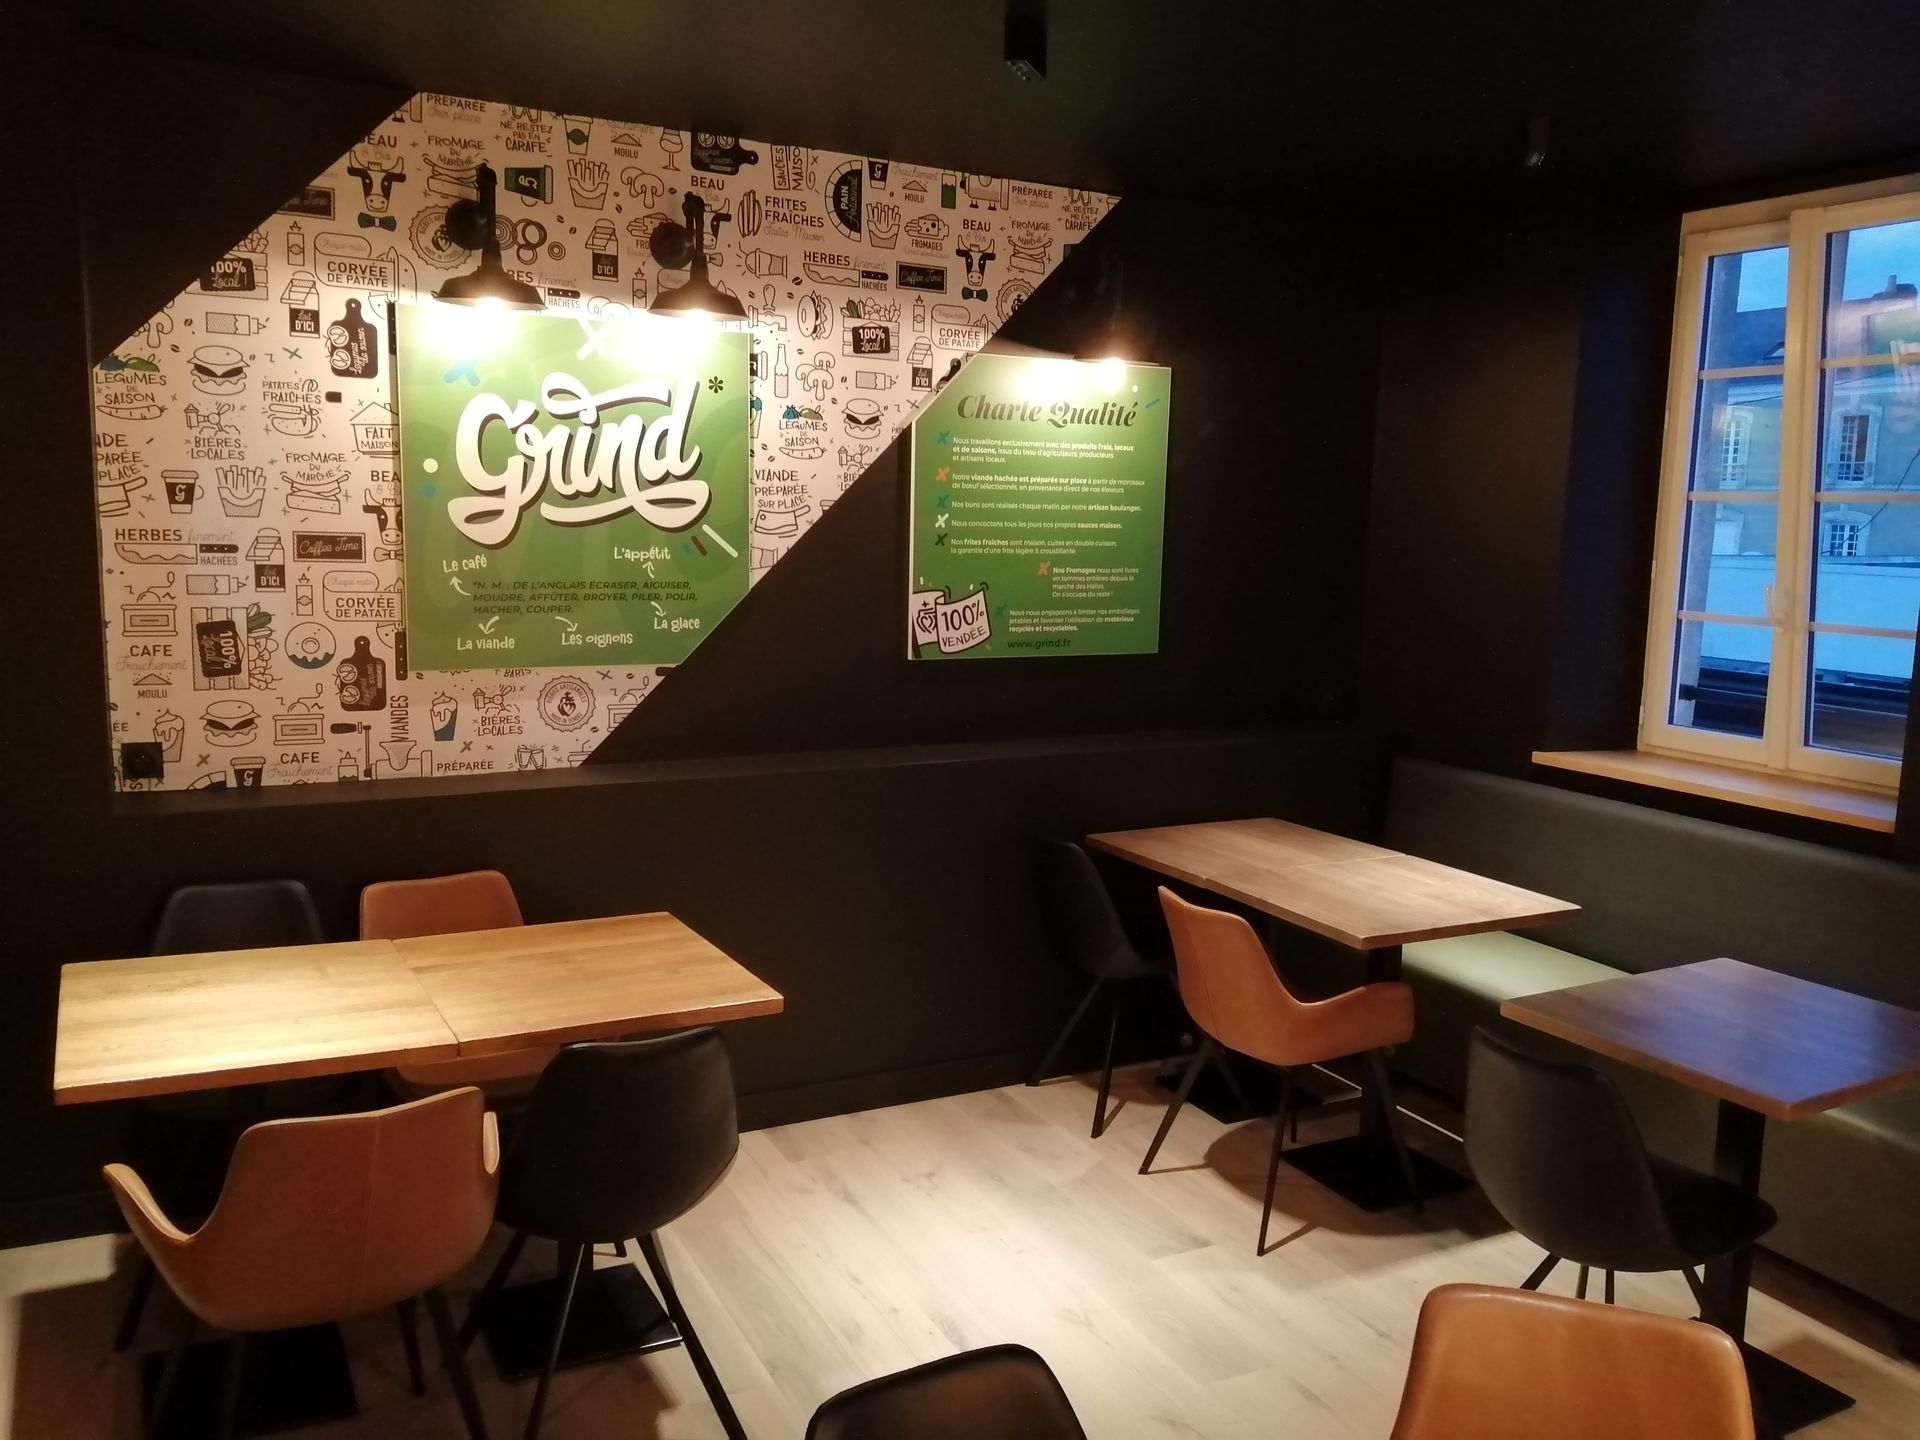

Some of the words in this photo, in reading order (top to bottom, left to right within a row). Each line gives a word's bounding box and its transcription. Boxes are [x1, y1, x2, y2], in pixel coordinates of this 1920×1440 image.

[428, 136, 486, 150] FROMAGE
[505, 136, 548, 153] CARAFE
[614, 146, 639, 159] MOULU
[691, 175, 725, 191] BEAU
[840, 185, 850, 210] PAIN
[904, 193, 925, 204] MOULU
[1012, 185, 1054, 200] PRÉPARÉE
[765, 195, 807, 212] FRITES
[765, 209, 825, 228] FRAÎCHES
[962, 219, 991, 233] BEAU
[1011, 220, 1051, 232] FROMAGE
[911, 239, 944, 252] FROMAGES
[803, 250, 850, 267] HERBES
[327, 261, 388, 278] CORVÉE
[327, 272, 343, 283] DE
[346, 274, 388, 288] PATATE
[861, 280, 888, 292] HACHÉES
[858, 328, 886, 340] 100%
[939, 326, 982, 341] CORVÉE
[938, 337, 950, 347] DE
[952, 338, 981, 349] PATATE
[262, 380, 300, 391] PATATES
[104, 392, 156, 405] SAISON
[957, 394, 1043, 422] Charte
[1047, 401, 1139, 429] Qualité
[365, 426, 394, 440] FAIT
[361, 440, 399, 450] MAISON
[784, 436, 819, 447] SAISON
[952, 437, 969, 445] Nous
[191, 448, 245, 462] LOCALES
[286, 452, 347, 465] FROMAGE
[448, 371, 713, 549] Grind
[99, 464, 141, 481] PLACE
[309, 463, 321, 472] DU
[755, 469, 799, 482] VIANDE
[952, 474, 971, 482] Notre
[1070, 477, 1087, 486] place
[755, 482, 809, 498] PRÉPARÉE
[758, 499, 776, 510] SUR
[778, 494, 805, 510] PLACE
[1077, 522, 1098, 530] sauces
[115, 528, 182, 541] HERBES
[300, 541, 333, 555] Coffee
[334, 537, 360, 551] Time
[200, 554, 238, 566] HACHÉES
[614, 546, 671, 561] L'appétit
[443, 559, 459, 573] Le
[462, 554, 488, 571] café
[260, 575, 280, 586] D'ICI
[513, 581, 529, 590] DE
[531, 581, 587, 590] L'ANGLAIS
[589, 579, 640, 591] ÉCRASER,
[642, 580, 692, 591] AIGUISER,
[336, 594, 396, 609] CORVÉE
[473, 593, 529, 603] MOUDRE,
[529, 590, 581, 602] AFFÛTER,
[583, 592, 629, 602] BROYER,
[632, 592, 663, 602] PILER,
[336, 608, 350, 618] DE
[354, 608, 396, 618] PATATE
[473, 604, 524, 615] HACHER,
[526, 604, 574, 614] COUPER.
[941, 600, 985, 632] 100%
[654, 617, 669, 630] La
[671, 617, 701, 632] glace
[456, 637, 473, 651] La
[475, 636, 515, 650] viande
[562, 633, 583, 646] Les
[586, 633, 633, 648] oignons
[942, 626, 987, 648] VENDÉE
[1007, 637, 1071, 650] www.grind.fr
[130, 645, 173, 657] CAFE
[219, 630, 238, 669] 100%
[137, 689, 168, 699] MOULU
[390, 695, 409, 742] VIANDES
[477, 725, 524, 737] LOCALES
[280, 752, 320, 765] CAFE
[436, 760, 494, 772] PRÉPARÉE
